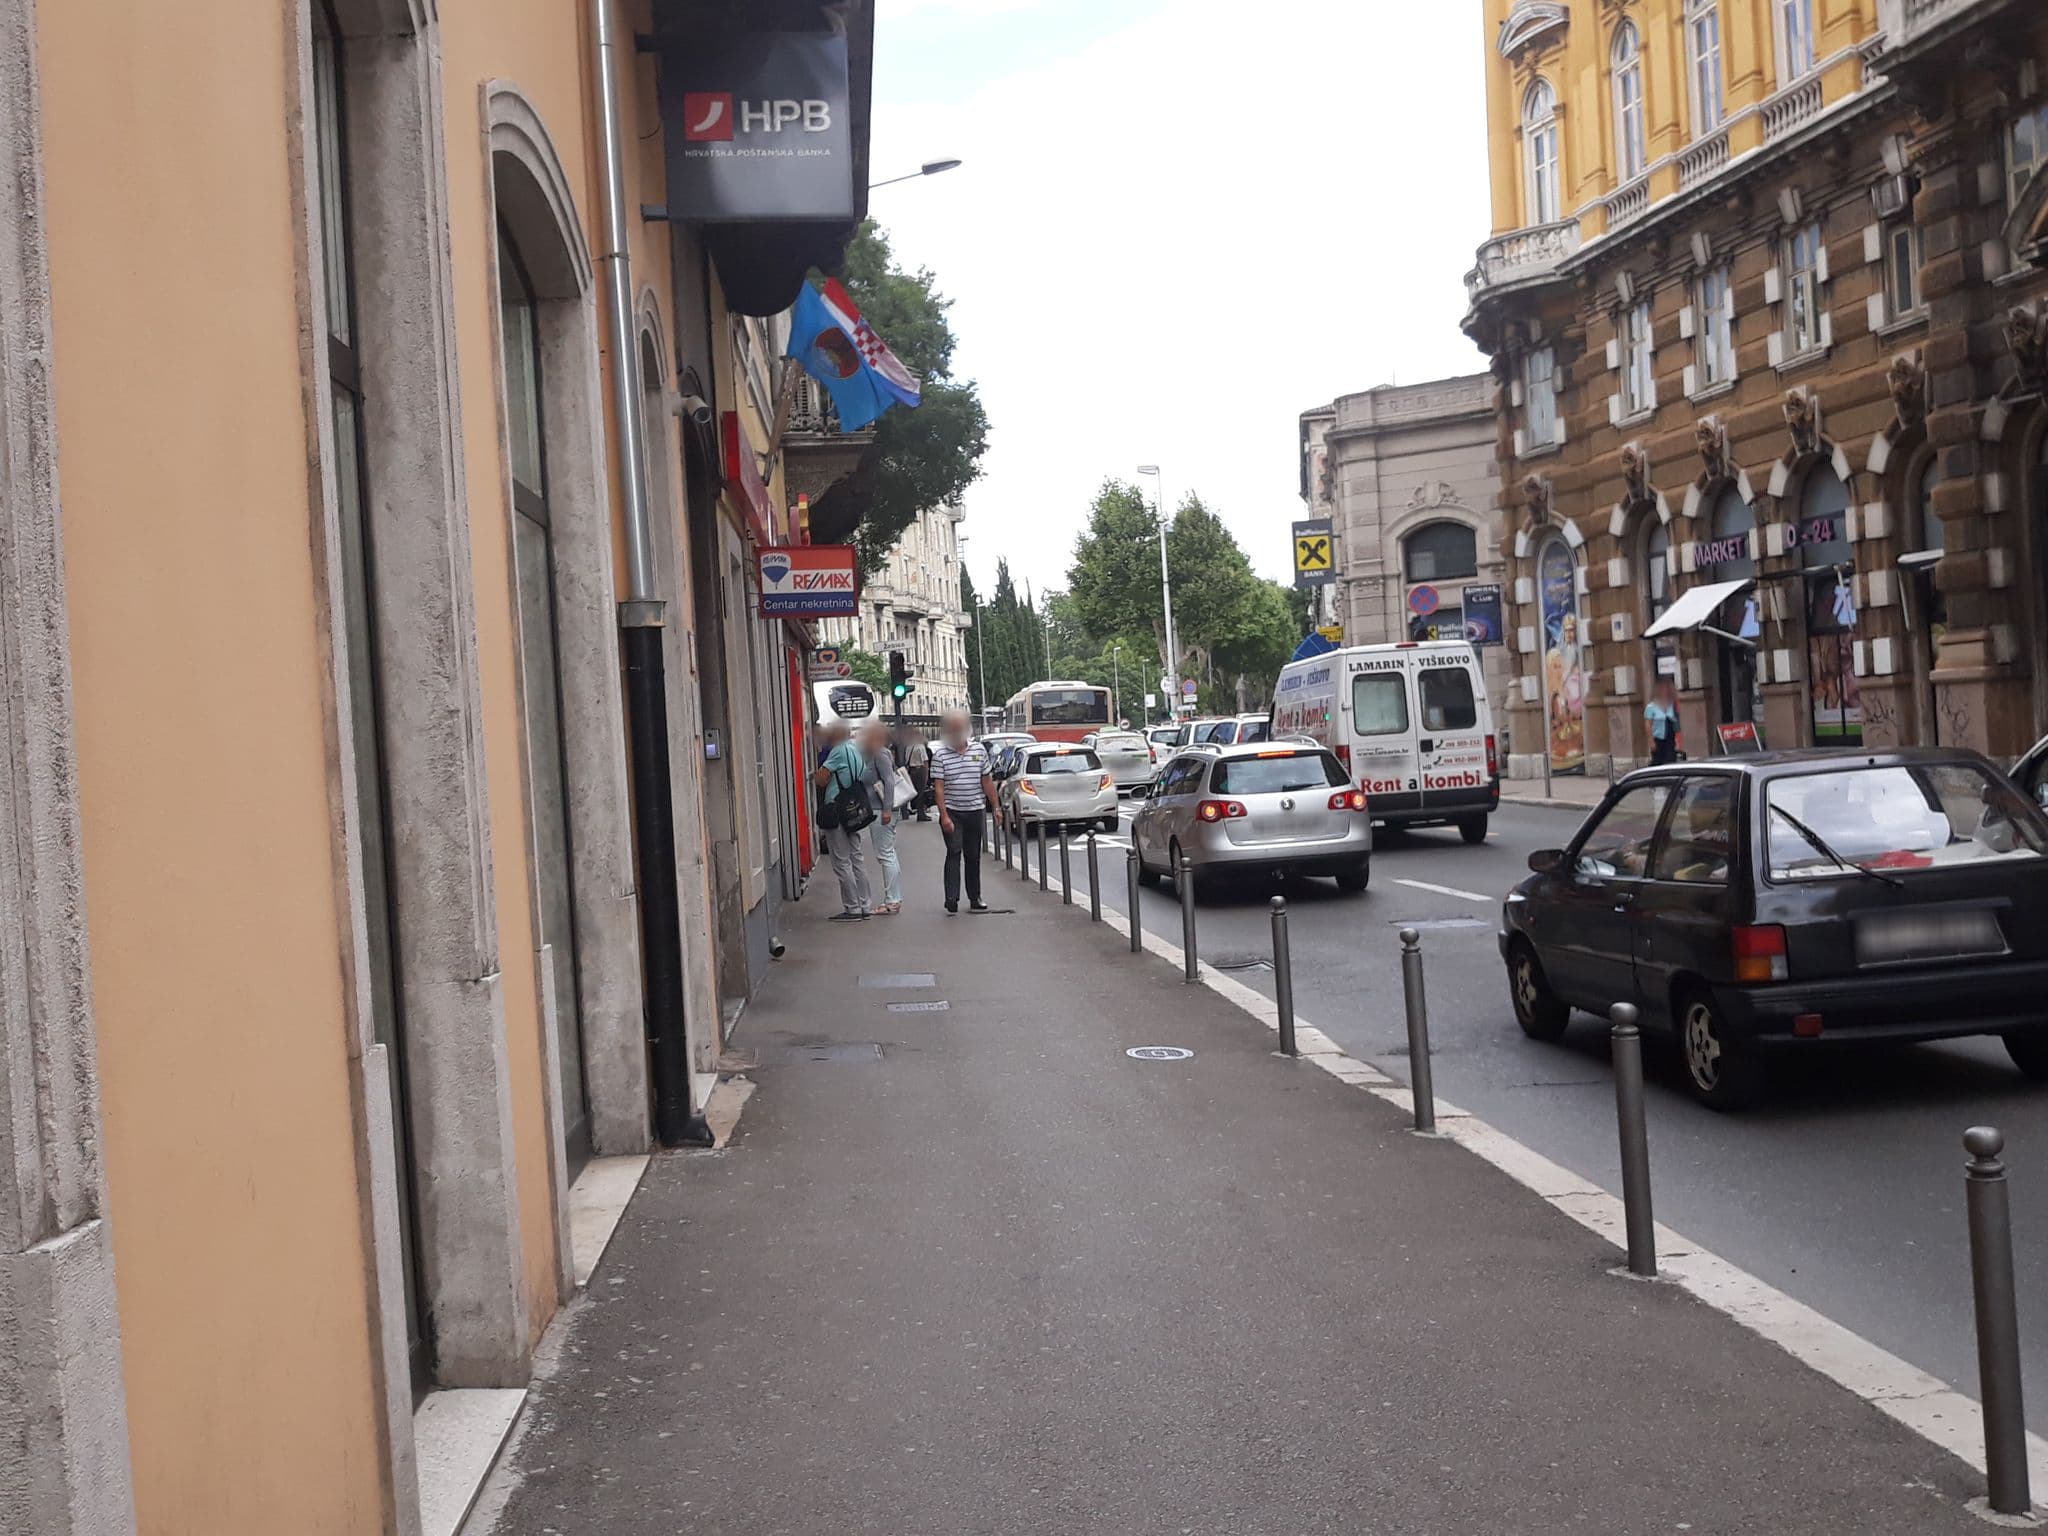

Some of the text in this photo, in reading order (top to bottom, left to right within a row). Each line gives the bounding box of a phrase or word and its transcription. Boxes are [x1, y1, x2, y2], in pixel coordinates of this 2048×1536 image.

[741, 100, 832, 132] HPB
[684, 149, 734, 157] HRVATSKA
[797, 149, 831, 157] BANKA
[1812, 519, 1832, 544] 24
[1694, 536, 1742, 566] MARKET
[793, 572, 852, 590] RE/MAX
[1304, 570, 1325, 578] BANK
[763, 599, 854, 610] Centar nekretnina
[1349, 660, 1404, 672] LAMARIN
[1418, 655, 1470, 667] VIŠKOVO
[1302, 699, 1328, 728] kombi
[1361, 770, 1480, 793] Rent a kombi
